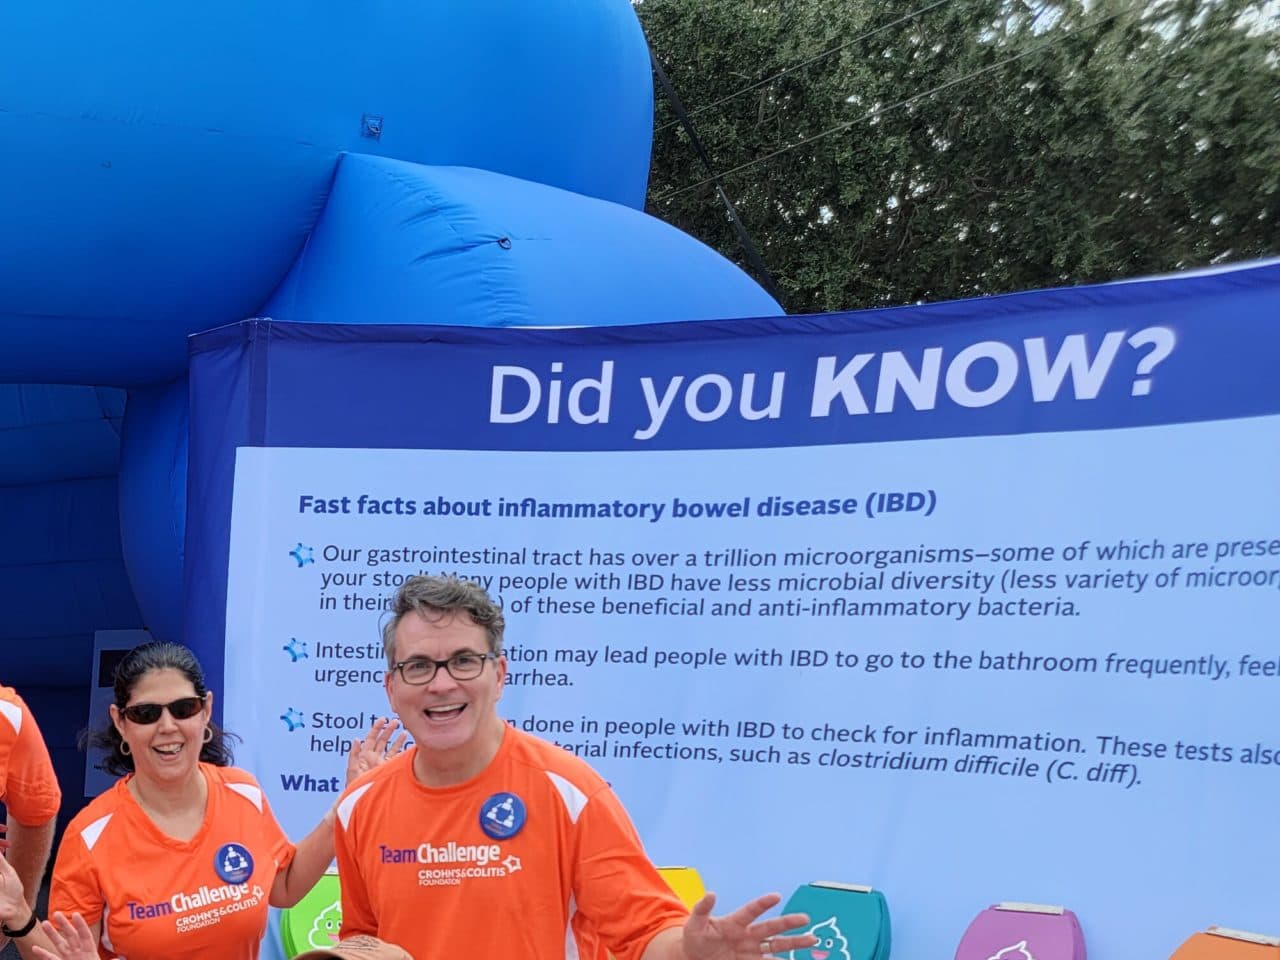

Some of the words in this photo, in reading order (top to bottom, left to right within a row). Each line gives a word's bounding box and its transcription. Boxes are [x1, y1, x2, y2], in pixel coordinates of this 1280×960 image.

[488, 360, 615, 425] Did
[633, 369, 785, 441] you
[809, 326, 1176, 418] KNOW?
[298, 495, 351, 515] Fast
[357, 494, 417, 516] facts
[422, 496, 492, 517] about
[498, 496, 663, 522] inflammatory
[672, 496, 750, 519] bowel
[756, 495, 858, 518] disease
[865, 489, 938, 519] (IBD)
[322, 545, 362, 562] Our
[367, 545, 526, 567] gastrointestinal
[532, 548, 584, 566] tract
[589, 548, 625, 567] has
[631, 552, 679, 568] over
[685, 552, 698, 568] a
[704, 548, 777, 568] trillion
[1061, 541, 1091, 563] of
[1097, 538, 1165, 561] which
[1171, 541, 1209, 559] are
[1214, 539, 1280, 562] prese
[320, 572, 369, 590] your
[499, 575, 571, 596] people
[574, 573, 621, 592] with
[627, 573, 665, 592] IBD
[670, 574, 722, 592] have
[728, 574, 772, 592] less
[778, 572, 885, 592] microbial
[891, 570, 995, 593] diversity
[1000, 568, 1057, 594] (less
[1065, 566, 1148, 594] variety
[1155, 565, 1182, 588] of
[1186, 566, 1280, 589] microor
[319, 592, 337, 610] in
[511, 596, 532, 615] of
[537, 597, 596, 616] these
[602, 596, 705, 617] beneficial
[712, 599, 751, 617] and
[757, 597, 971, 621] anti-inflammatory
[977, 597, 1081, 618] bacteria.
[314, 668, 385, 688] urgenc
[503, 668, 573, 687] arrhea.
[554, 649, 599, 667] may
[604, 645, 649, 665] lead
[654, 648, 727, 669] people
[734, 647, 783, 667] with
[789, 650, 829, 668] IBD
[834, 651, 859, 668] to
[865, 653, 894, 673] go
[900, 652, 925, 670] to
[932, 650, 973, 670] the
[978, 650, 1098, 674] bathroom
[1105, 651, 1232, 680] frequently,
[312, 712, 364, 730] Stool
[522, 714, 574, 733] done
[581, 716, 598, 734] in
[605, 719, 678, 740] people
[682, 717, 730, 737] with
[736, 721, 775, 739] IBD
[781, 723, 805, 741] to
[810, 723, 877, 743] check
[883, 725, 917, 746] for
[924, 727, 1087, 754] inflammation.
[1096, 735, 1168, 759] These
[1175, 740, 1234, 763] tests
[310, 734, 352, 756] help
[613, 740, 724, 763] infections,
[729, 742, 781, 764] such
[787, 750, 811, 766] as
[818, 747, 948, 773] clostridium
[954, 753, 1040, 779] difficile
[1045, 759, 1079, 784] (C.
[1086, 761, 1142, 790] diff).
[281, 774, 340, 793] What
